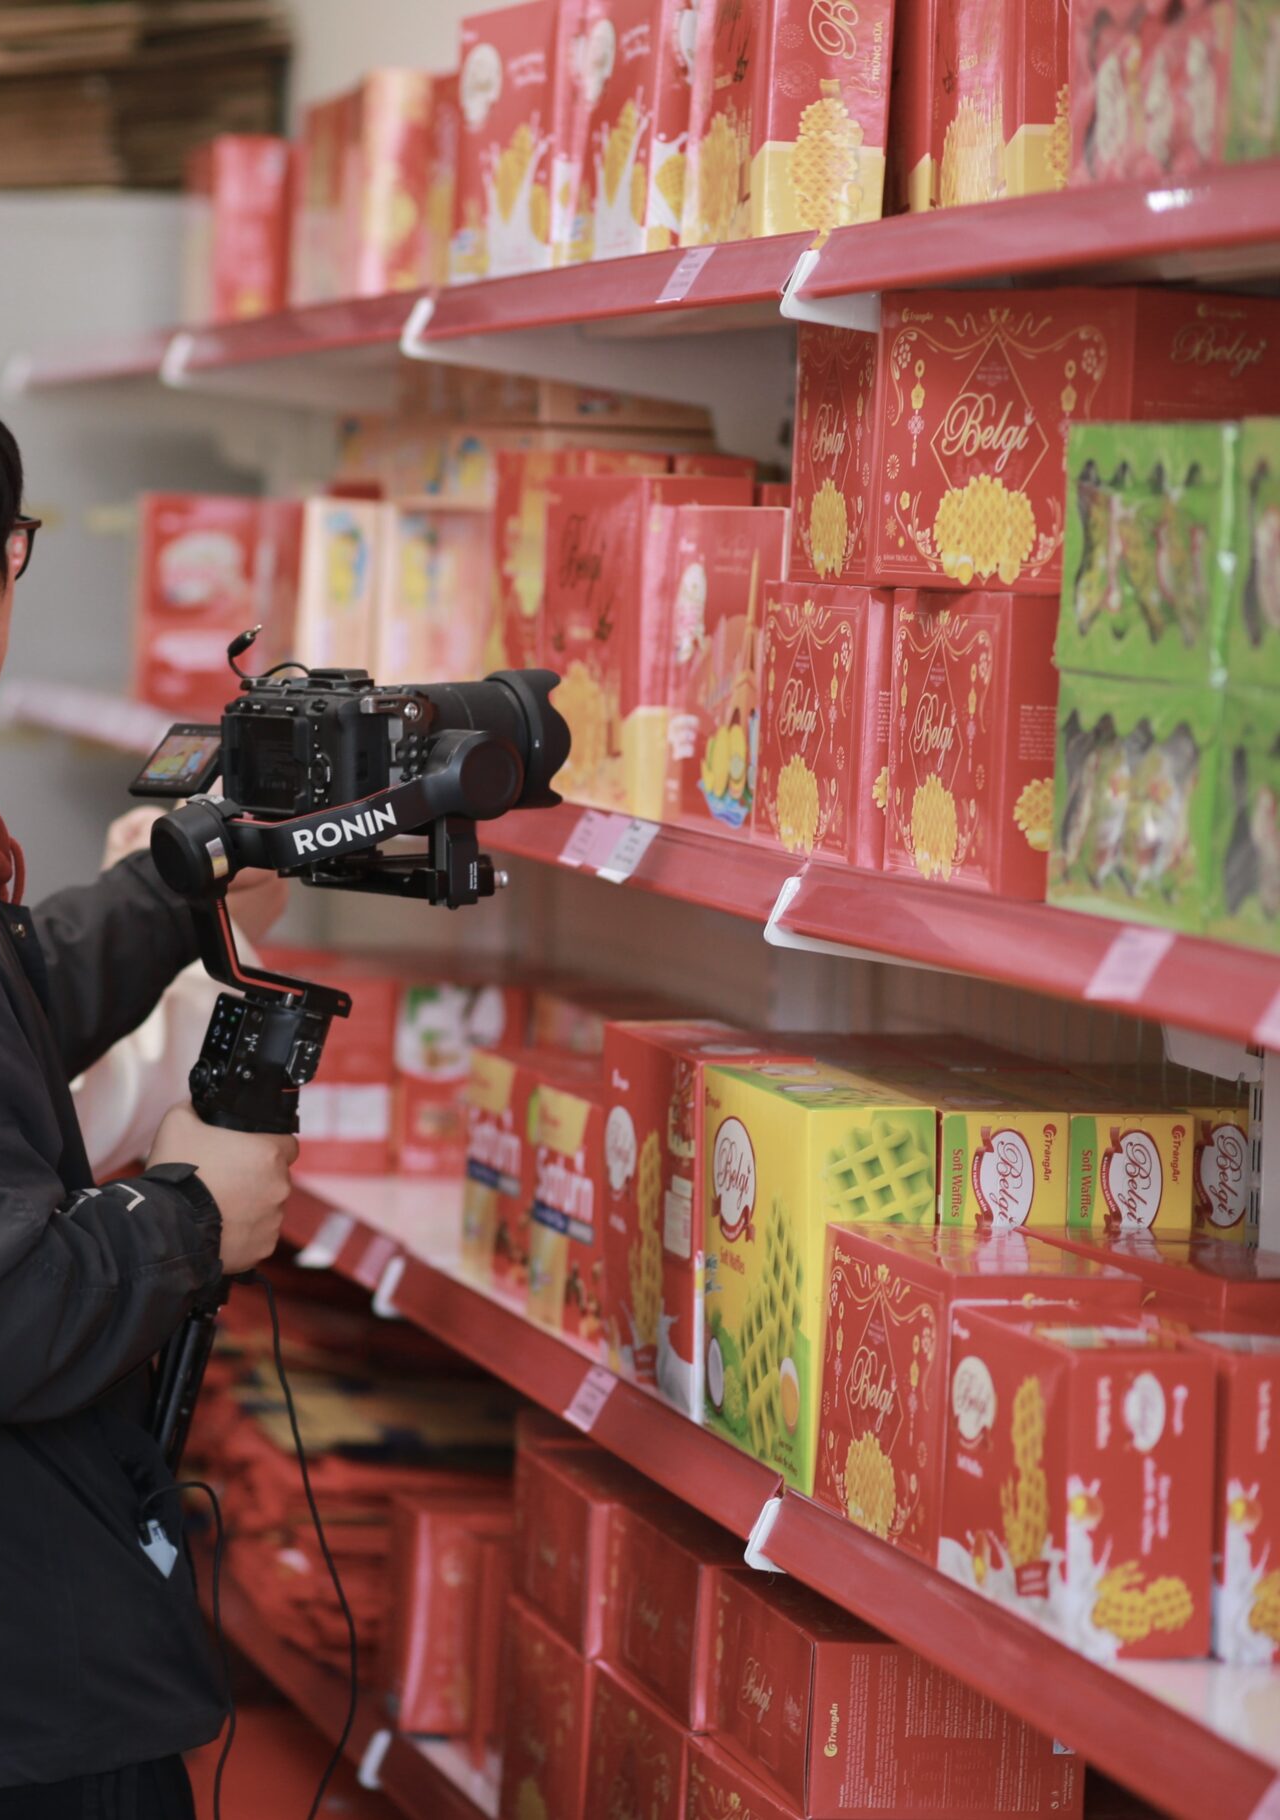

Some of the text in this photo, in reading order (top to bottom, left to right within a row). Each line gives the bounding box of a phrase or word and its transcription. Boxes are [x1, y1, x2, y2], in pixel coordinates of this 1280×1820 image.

[1168, 320, 1269, 379] Belgi
[812, 403, 847, 475] Belgi
[942, 394, 1034, 473] Belgi
[779, 677, 820, 753] Belgi
[913, 692, 957, 772] Belgi
[292, 802, 397, 856] RONIN
[717, 1137, 752, 1210] Belgi
[951, 1148, 964, 1217] Soft Waffles
[989, 1141, 1024, 1223] Belgi
[1080, 1149, 1093, 1218] Soft Waffles
[1118, 1142, 1153, 1224] Belgi
[1209, 1134, 1244, 1216] Belgi
[850, 1345, 896, 1433] Belgi
[742, 1656, 773, 1724] Belgi
